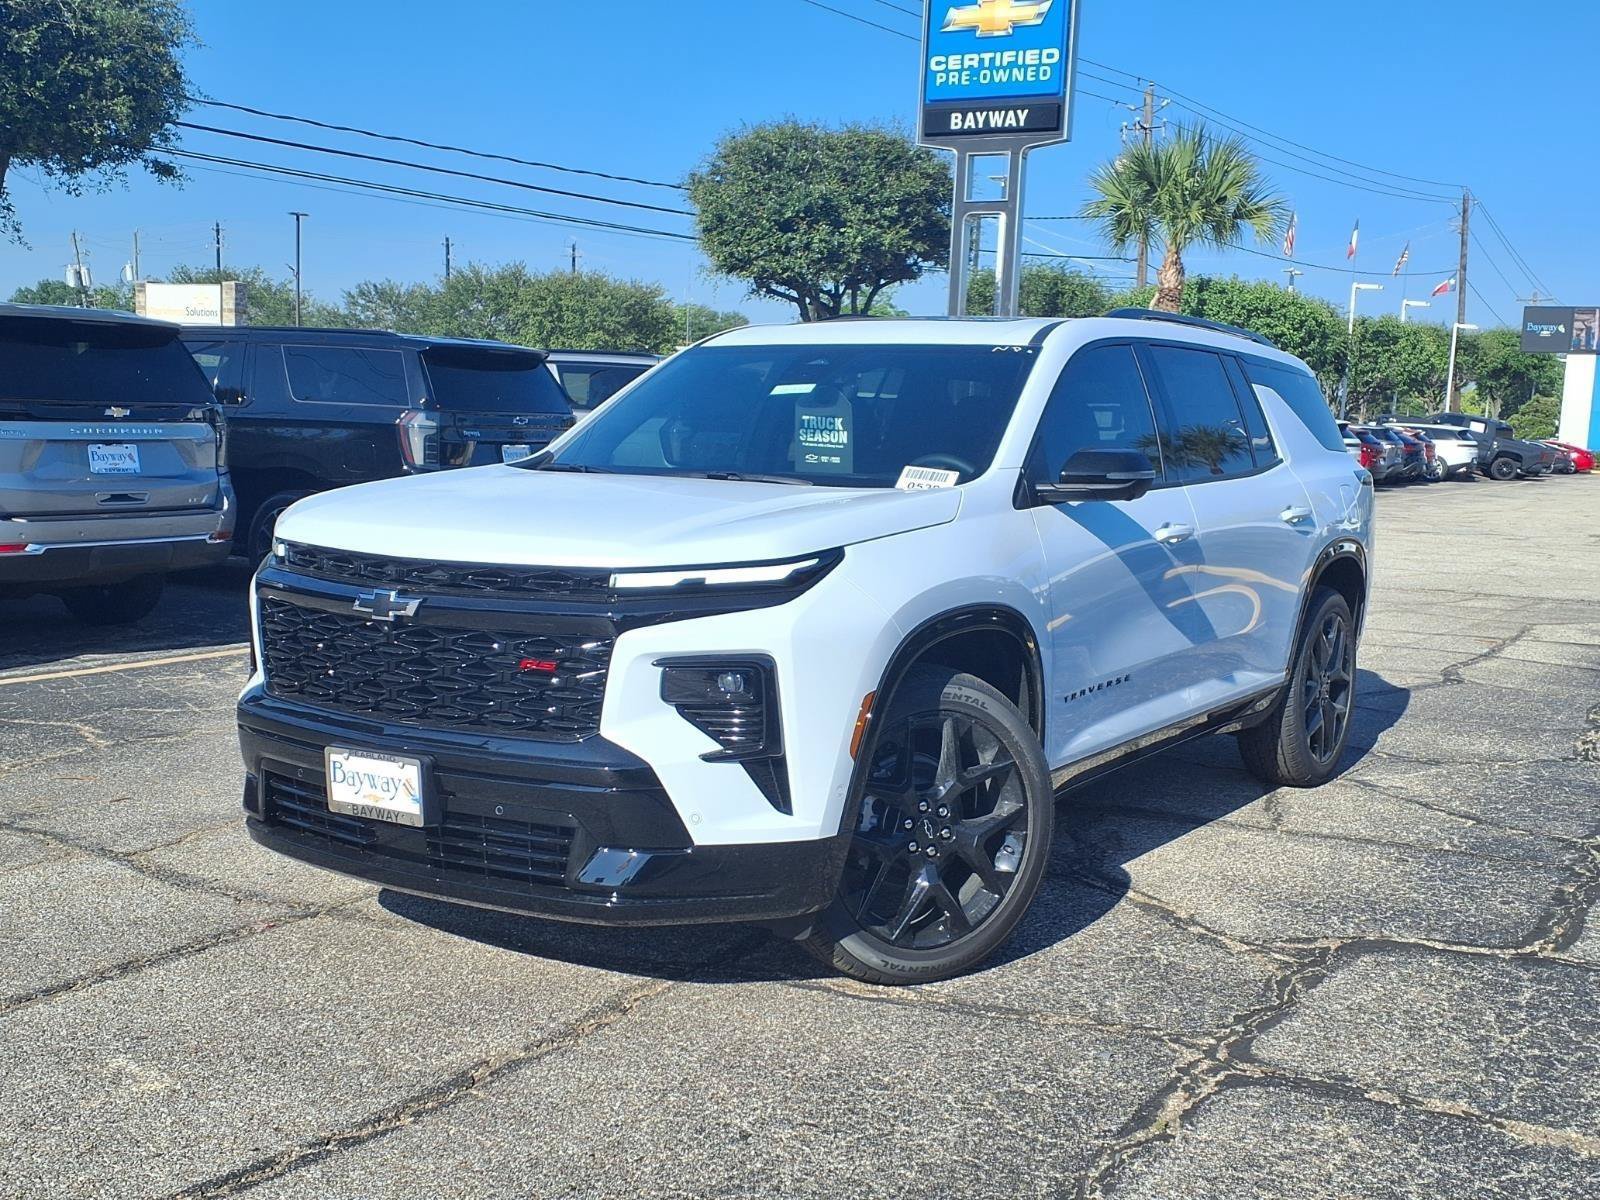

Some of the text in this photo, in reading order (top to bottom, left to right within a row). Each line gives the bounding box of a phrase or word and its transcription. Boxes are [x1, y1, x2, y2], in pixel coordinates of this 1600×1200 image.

[930, 48, 1060, 71] CERTIFIED
[936, 66, 1051, 87] PRE-OWNED
[950, 109, 1029, 130] BAYWAY
[185, 306, 218, 317] Solutions
[1527, 322, 1557, 334] Bayway
[802, 415, 843, 431] TRUCK
[799, 428, 848, 444] SEASON
[91, 450, 128, 465] Bayway
[1064, 674, 1130, 704] TRAVERSE
[332, 760, 402, 801] Bayway
[352, 804, 400, 823] BAYWAY
